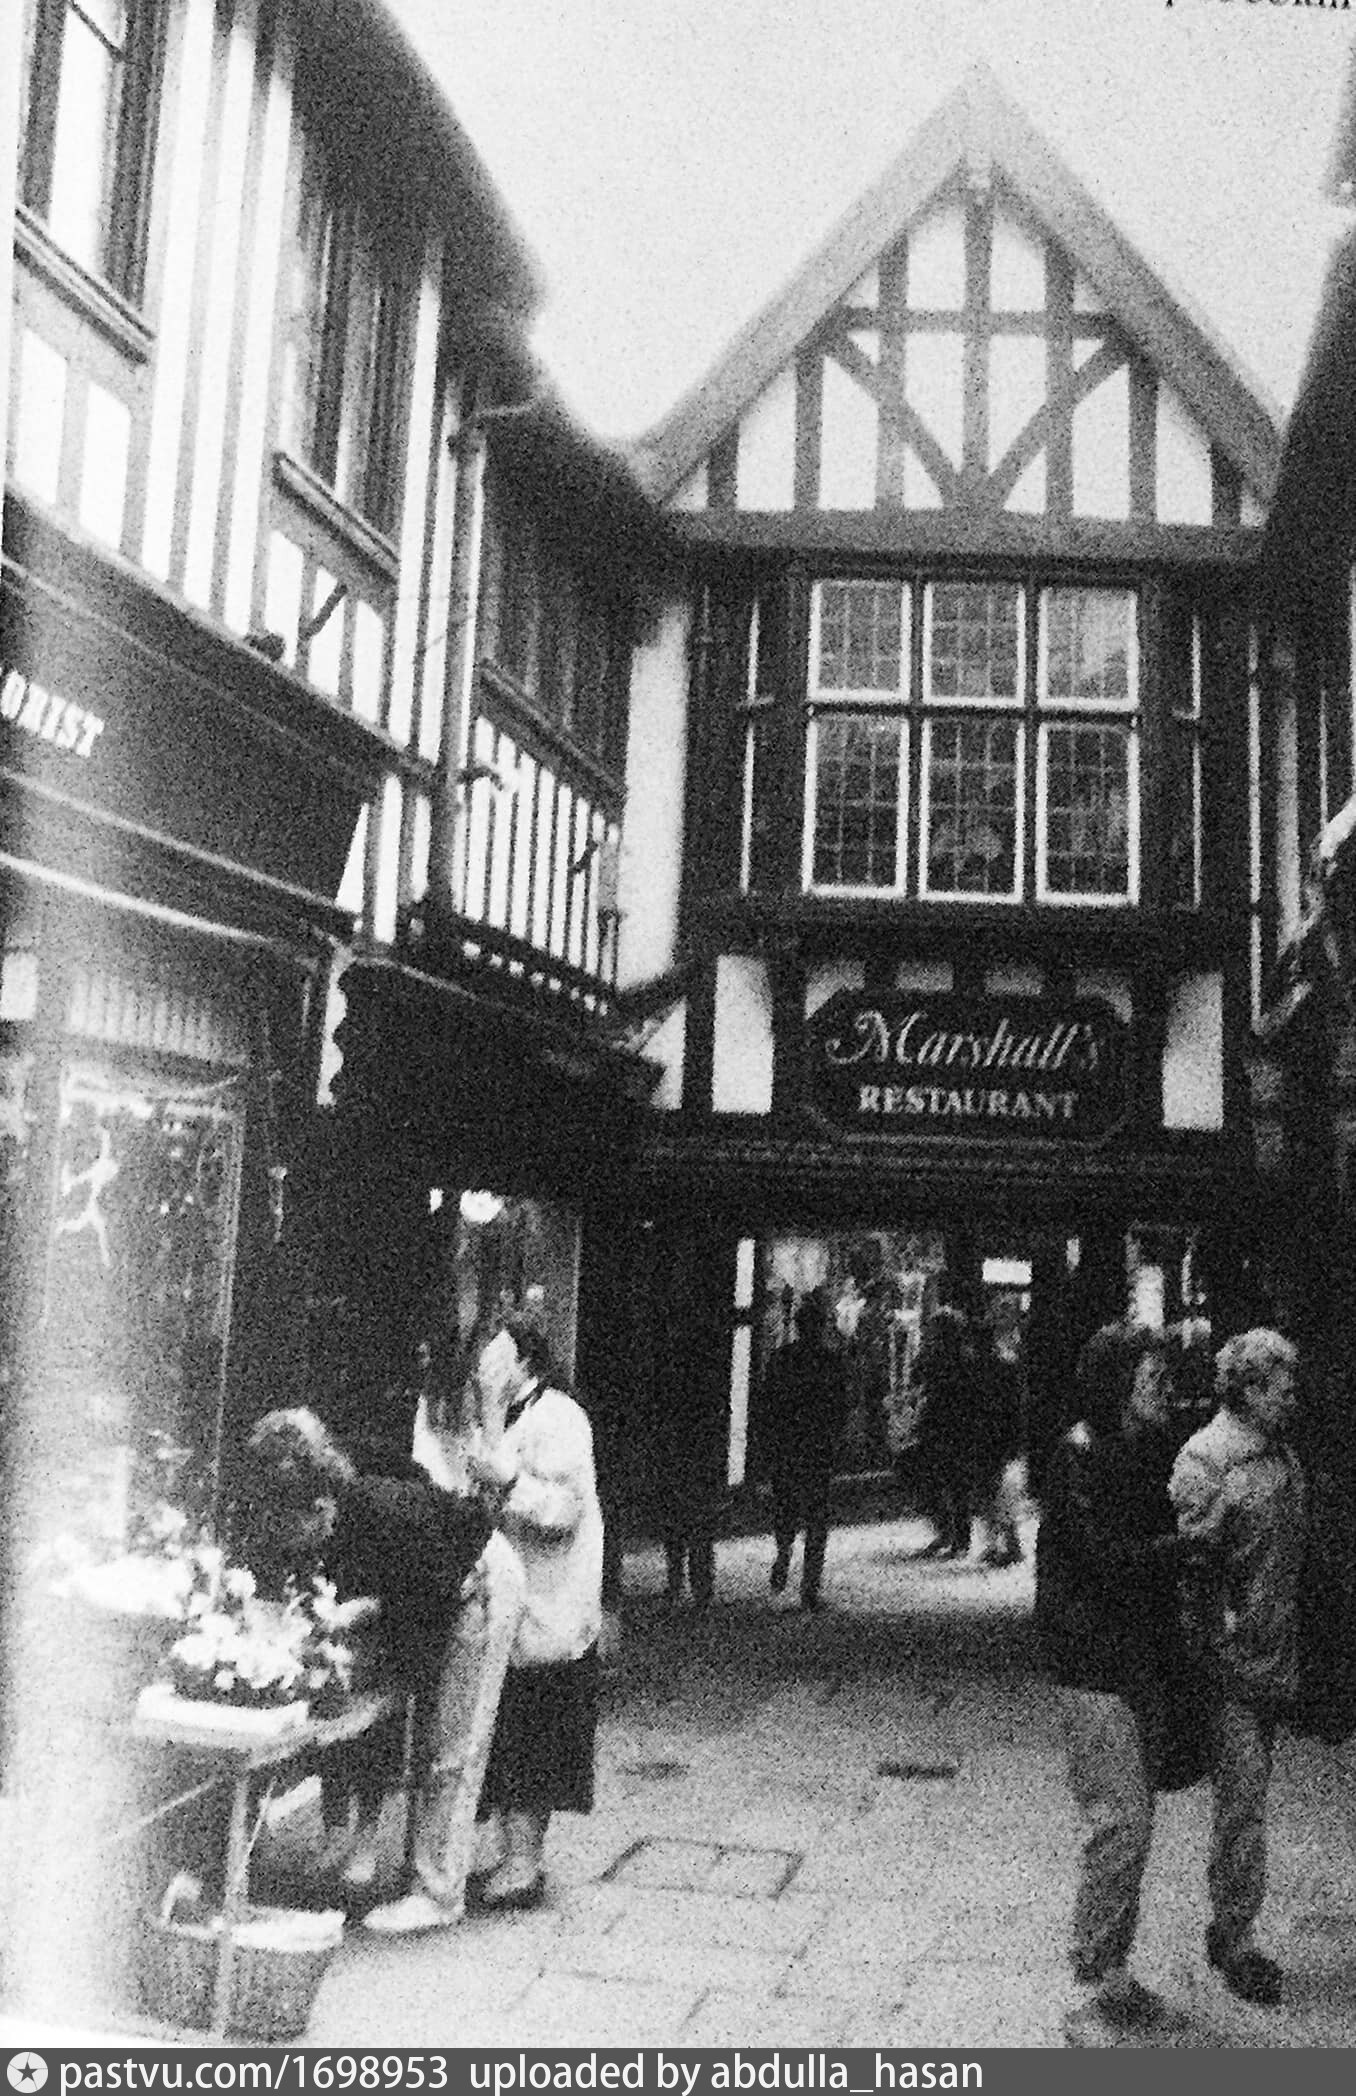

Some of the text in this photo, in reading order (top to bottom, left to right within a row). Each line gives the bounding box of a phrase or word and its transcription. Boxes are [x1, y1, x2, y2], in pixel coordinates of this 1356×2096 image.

[0, 667, 105, 758] ORIST
[825, 1009, 1099, 1071] Marshall's
[857, 1084, 1079, 1119] RESTAURANT
